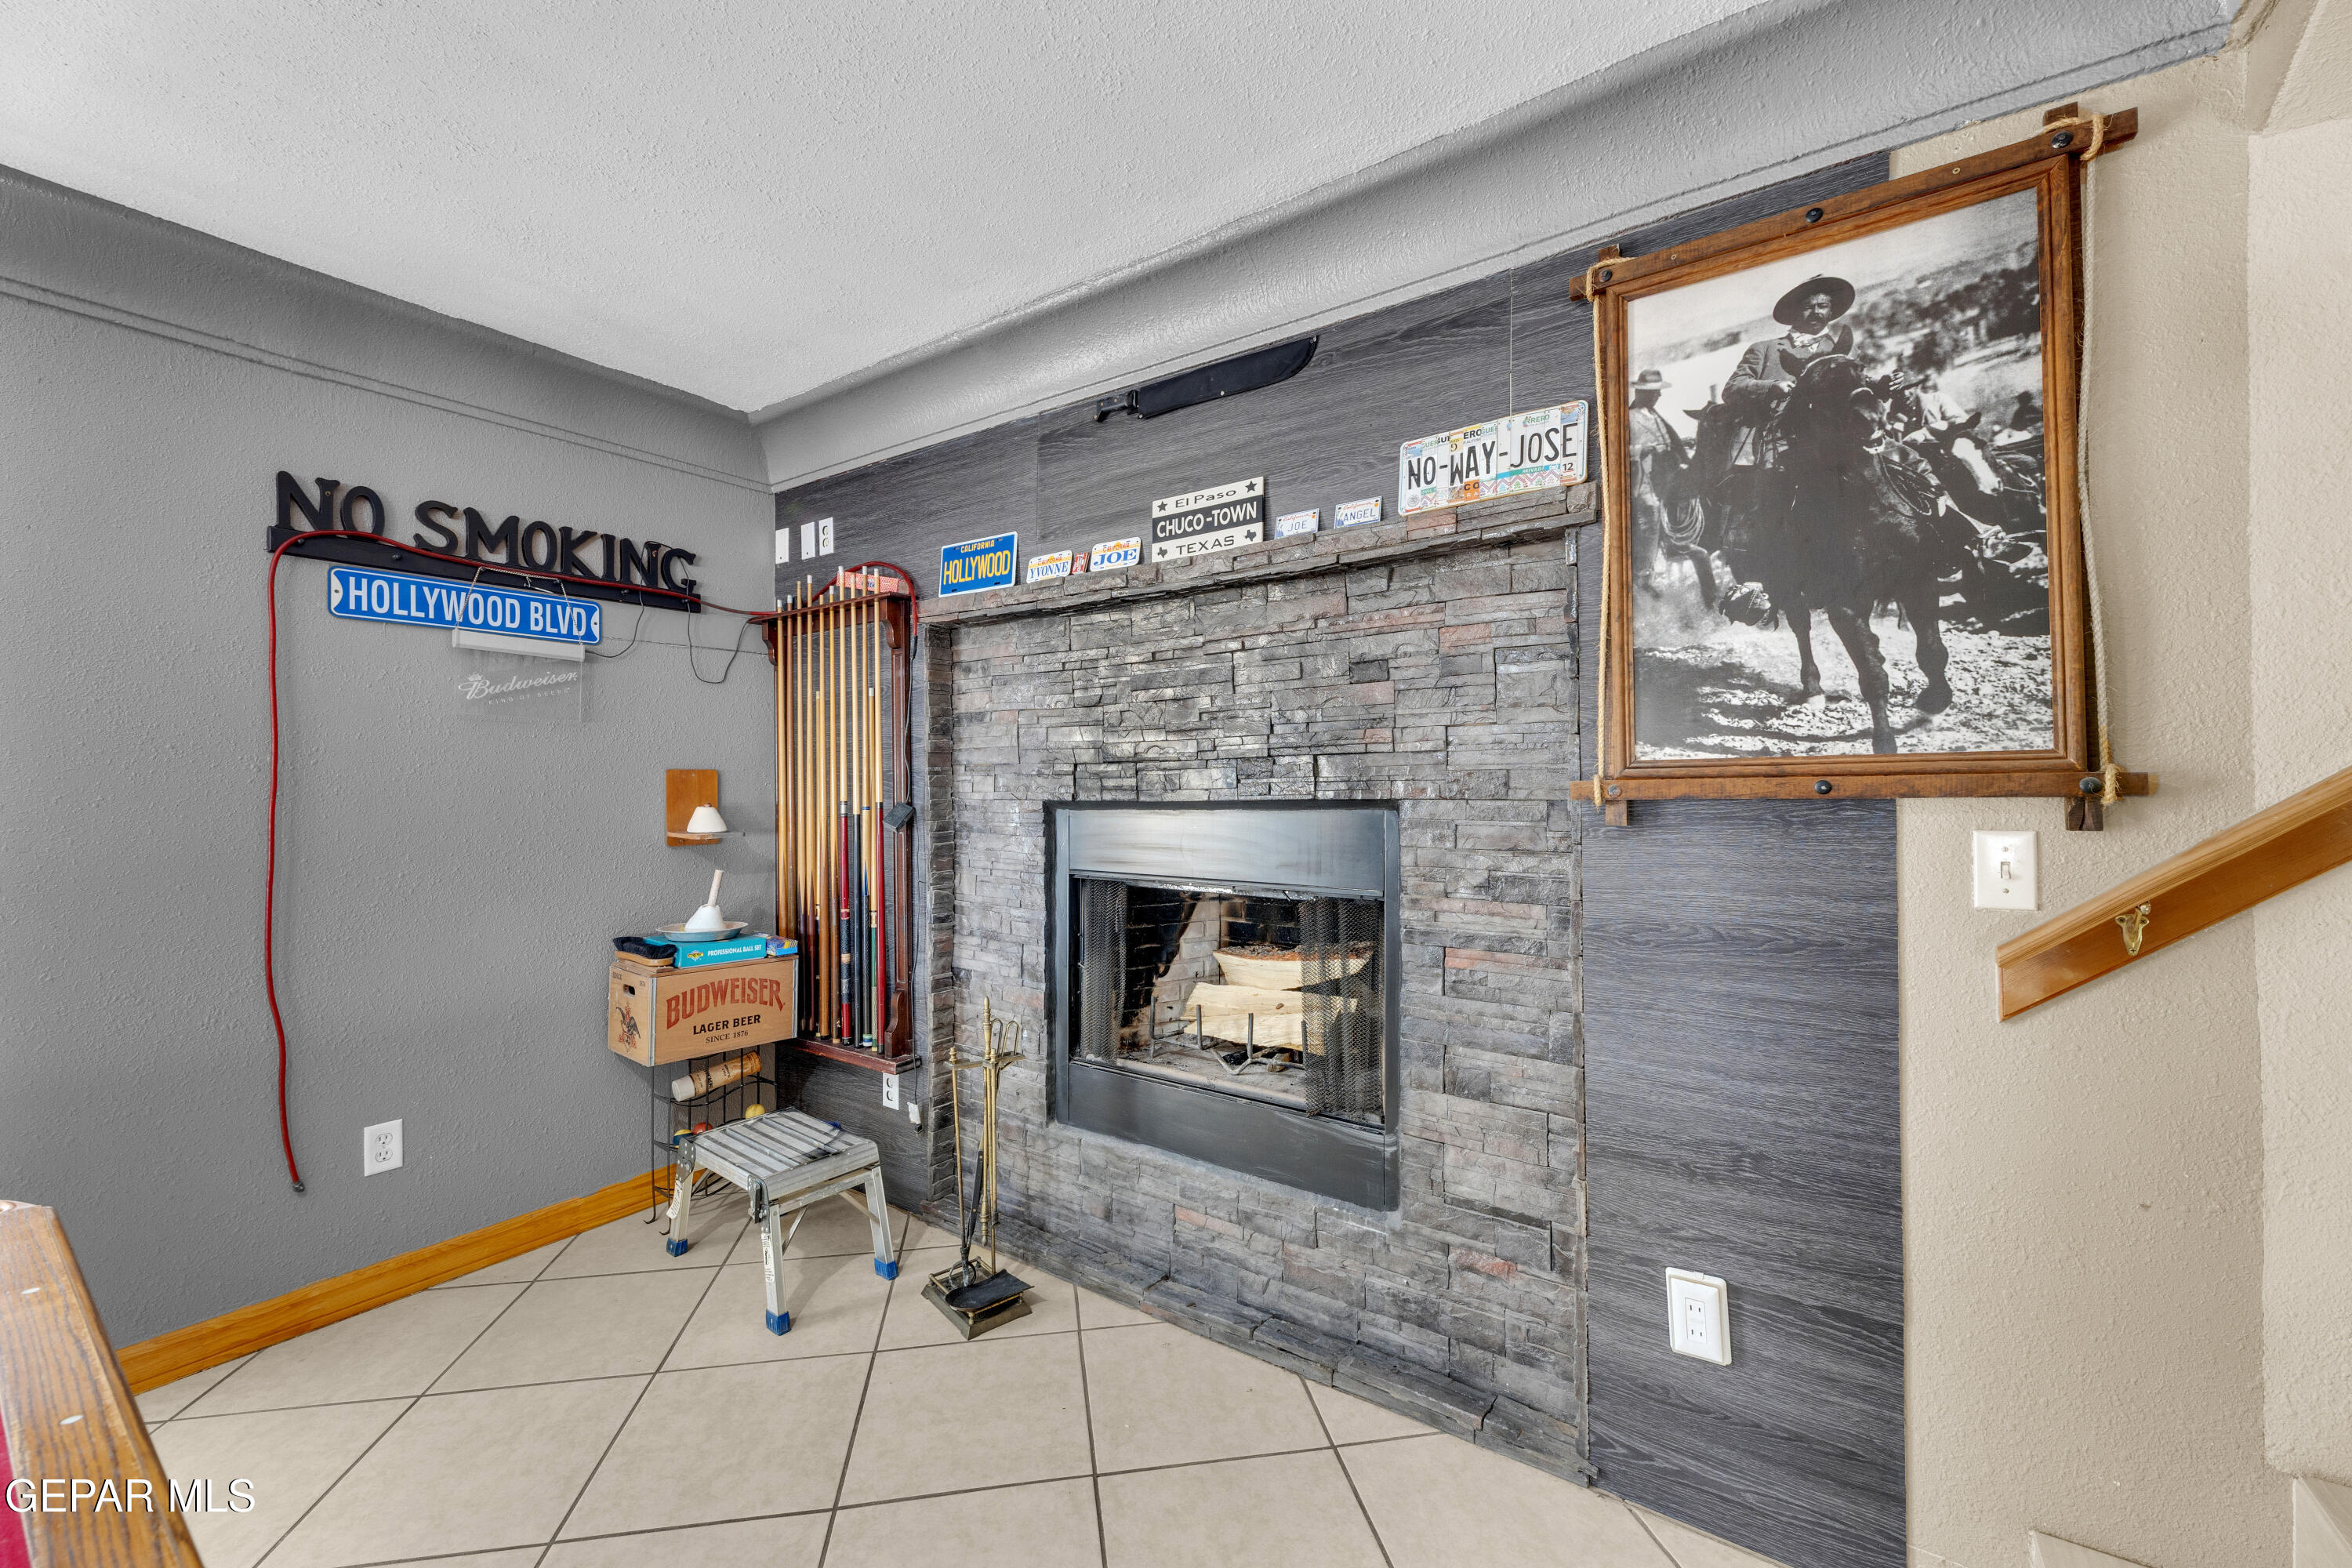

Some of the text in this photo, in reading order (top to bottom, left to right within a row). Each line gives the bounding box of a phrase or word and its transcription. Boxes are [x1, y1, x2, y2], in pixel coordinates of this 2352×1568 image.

[1408, 423, 1577, 490] NO-WAY-JOSE
[1563, 463, 1573, 471] 12
[1175, 490, 1236, 508] El Paso
[1343, 507, 1376, 522] ANGEL
[276, 470, 698, 594] NO SMOKING
[1287, 520, 1308, 532] JOE
[960, 539, 995, 554] CALIFORNIA
[1102, 543, 1131, 554] CALIFORNIA
[1176, 535, 1235, 555] TEXAS
[1093, 548, 1138, 566] JOE
[943, 550, 1011, 586] HOLLYWOOD
[1029, 561, 1069, 579] YVONNE
[349, 576, 587, 637] HOLLYWOOD BLVD
[458, 671, 578, 700] Budweiser
[707, 947, 742, 956] PROFESSIONAL
[666, 978, 784, 1030] BUDWEISER
[693, 1014, 761, 1035] LAGER BEER
[706, 1029, 749, 1044] SINCE 1876
